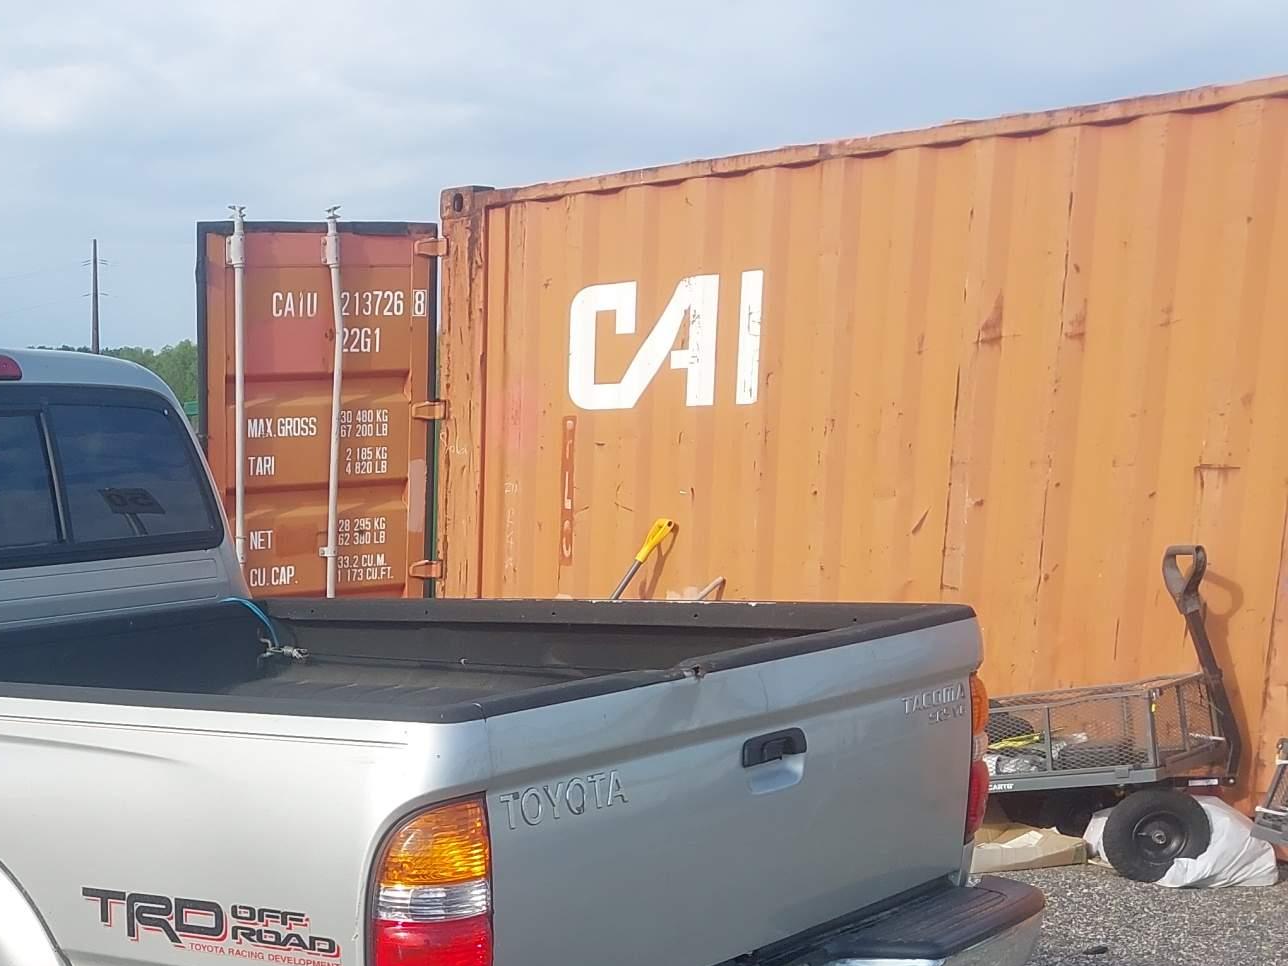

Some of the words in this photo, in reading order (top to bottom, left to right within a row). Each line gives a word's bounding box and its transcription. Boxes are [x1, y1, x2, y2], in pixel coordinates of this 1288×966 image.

[272, 291, 318, 318] CAIU
[341, 290, 404, 316] 213726
[342, 327, 381, 353] 22G1
[568, 270, 764, 411] CAI
[340, 410, 353, 424] 30
[356, 409, 374, 423] 480
[376, 409, 389, 422] KG
[247, 417, 318, 438] MAX.GROSS
[340, 424, 353, 438] 67
[355, 423, 374, 437] 200
[376, 422, 388, 437] LB
[346, 447, 352, 461] 2
[356, 446, 373, 461] 185
[375, 446, 388, 460] KG
[345, 461, 352, 475] 4
[355, 460, 373, 474] 820
[375, 460, 387, 474] LB
[338, 519, 351, 532] 28
[353, 518, 372, 531] 295
[374, 517, 386, 530] KG
[249, 530, 274, 550] NET
[338, 532, 351, 546] 62
[373, 530, 386, 544] LB
[337, 555, 359, 569] 33.2
[347, 568, 364, 582] 173
[901, 682, 966, 714] TACOMA
[499, 769, 629, 830] TOYOTA
[81, 886, 228, 949] TRD
[230, 904, 310, 930] OFF
[188, 941, 226, 956] TOYOTA
[228, 948, 265, 962] RACING
[230, 925, 341, 958] ROAD
